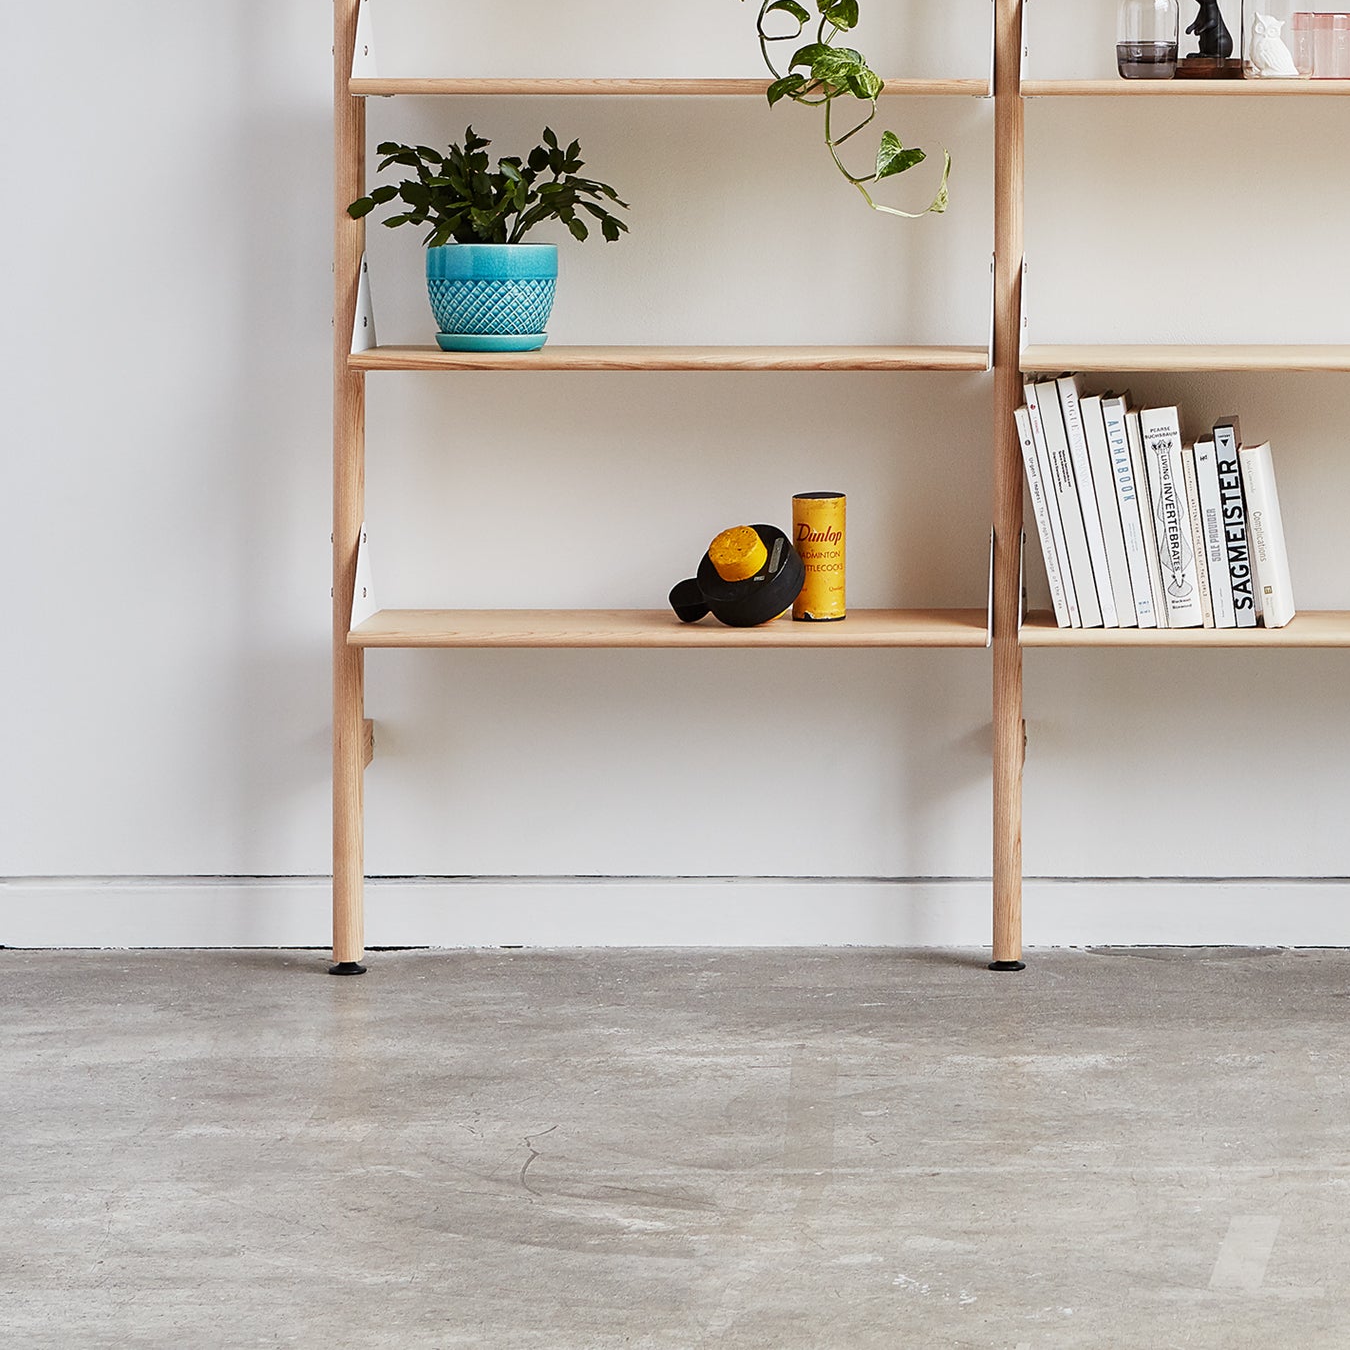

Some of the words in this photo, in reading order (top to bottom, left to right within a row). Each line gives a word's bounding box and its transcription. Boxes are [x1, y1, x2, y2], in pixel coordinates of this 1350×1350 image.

[1066, 393, 1081, 431] VOGUE
[1144, 431, 1178, 440] BUCHSBAUM
[1149, 425, 1171, 434] PEARSE
[1028, 456, 1037, 478] Urgent
[1107, 419, 1136, 503] ALPHABOOK
[1160, 454, 1171, 481] LIVING
[796, 522, 842, 546] Dunlop
[1163, 482, 1181, 572] INVERTEBRATES
[1206, 507, 1220, 543] PROVIDER
[1218, 459, 1254, 610] SAGMEISTER
[1252, 511, 1267, 563] Complications
[801, 550, 841, 560] ADMINTON
[1210, 544, 1221, 563] SOLE
